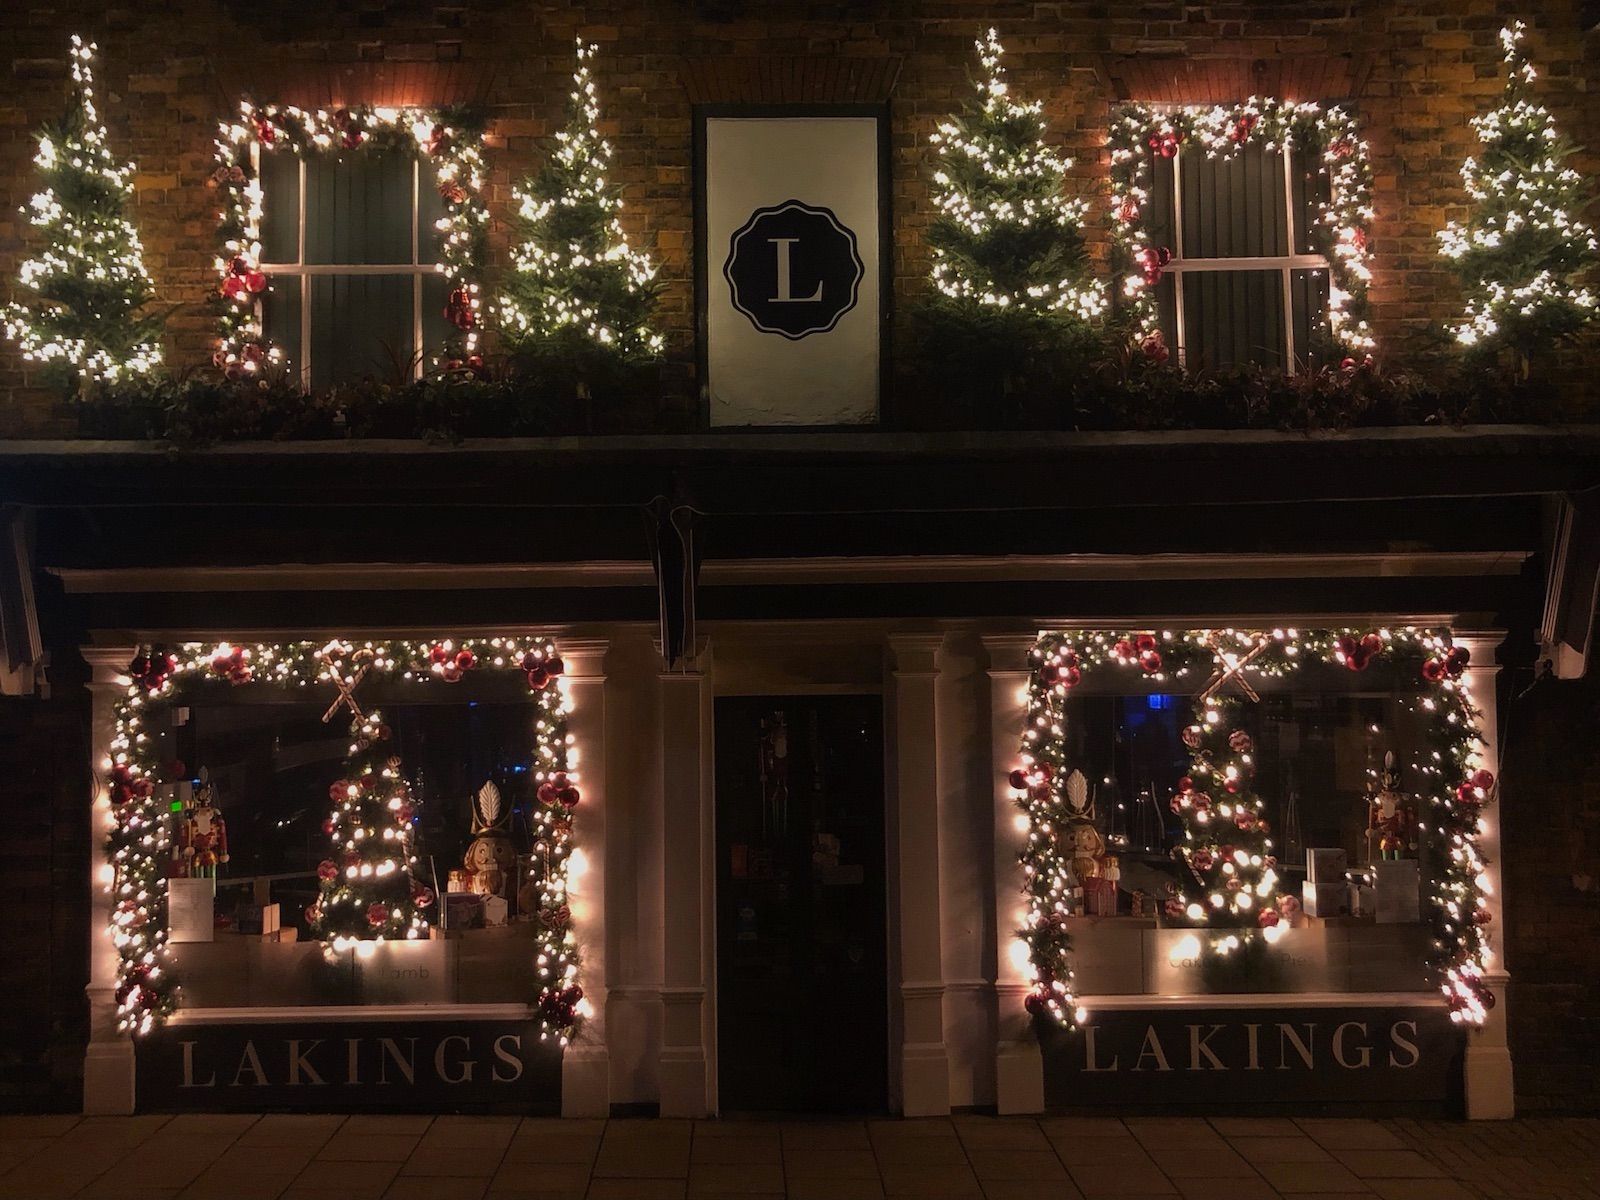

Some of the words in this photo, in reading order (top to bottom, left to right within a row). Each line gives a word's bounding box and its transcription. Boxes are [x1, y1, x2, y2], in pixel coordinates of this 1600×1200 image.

[767, 237, 824, 303] L
[177, 1034, 526, 1088] LAKINGS
[1080, 1020, 1421, 1073] LAKINGS
